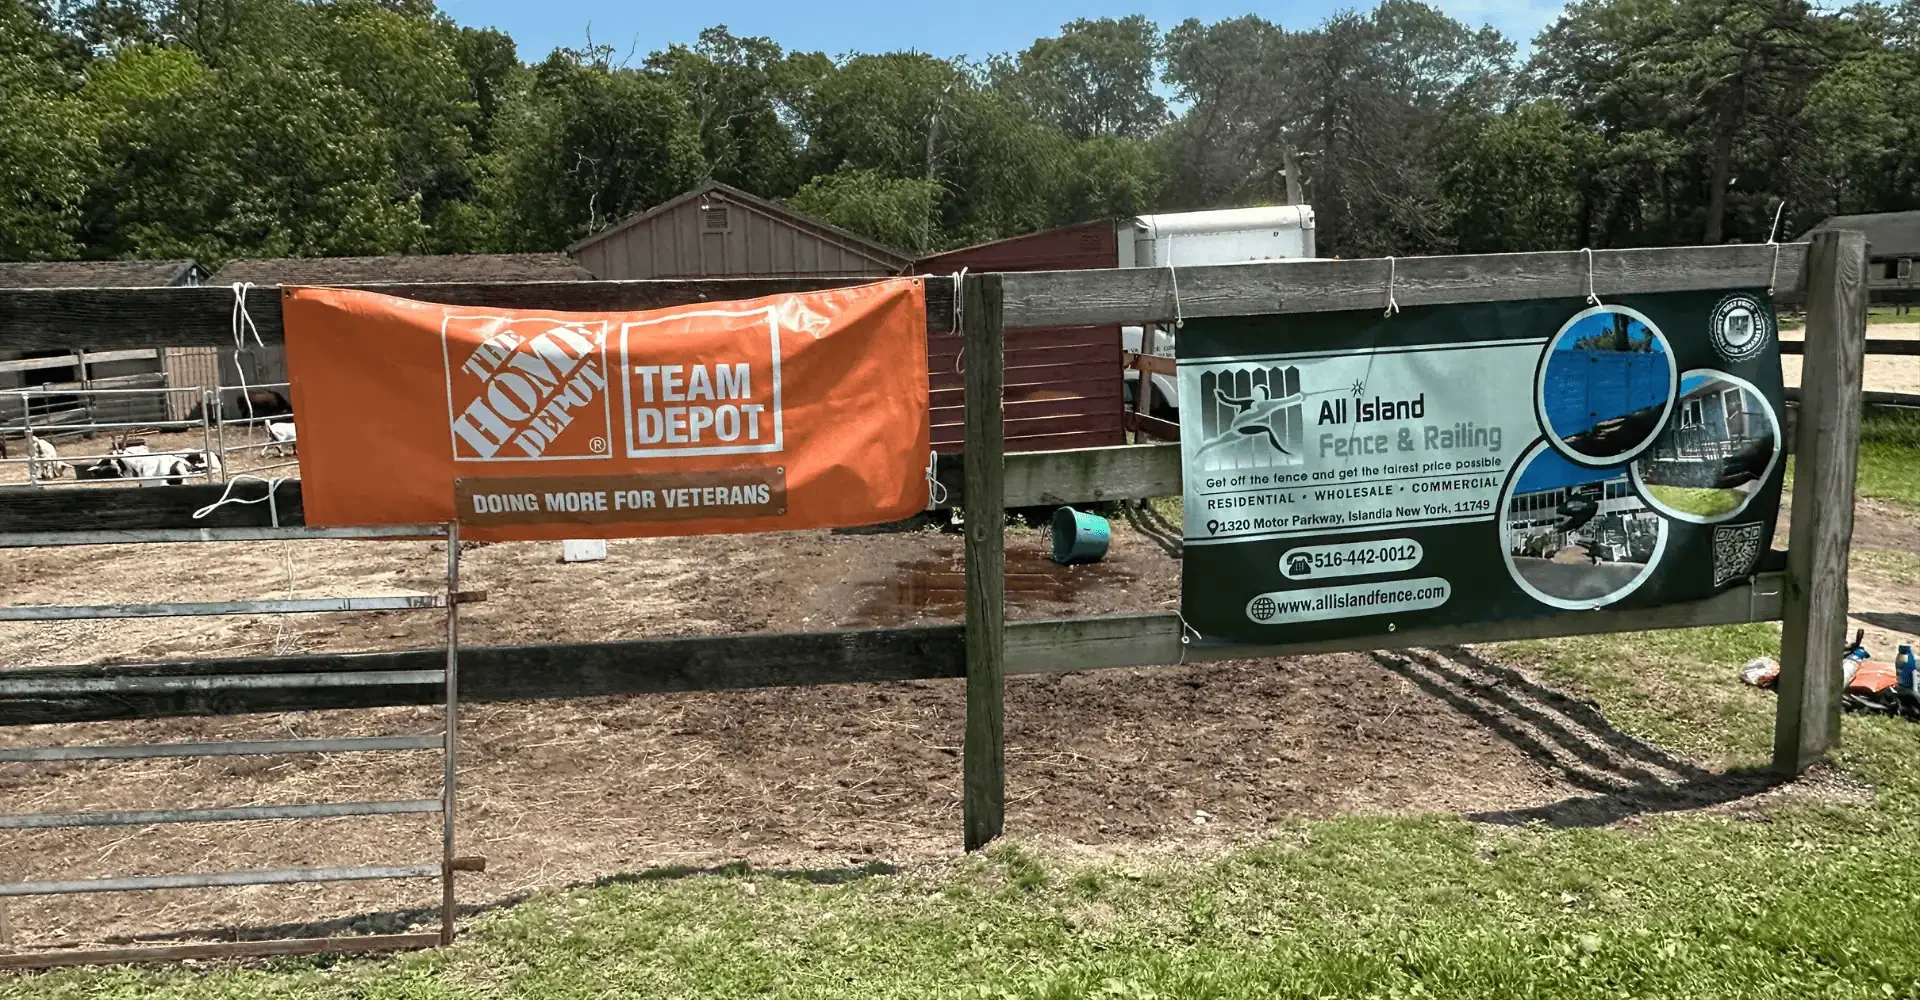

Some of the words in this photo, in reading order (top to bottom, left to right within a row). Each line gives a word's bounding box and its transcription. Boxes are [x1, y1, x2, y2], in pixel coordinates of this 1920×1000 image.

[461, 330, 526, 383] THE
[453, 323, 607, 458] HOME
[634, 363, 751, 402] TEAM
[513, 360, 606, 458] DEPOT
[637, 404, 765, 444] DEPOT
[1318, 398, 1347, 426] All
[1355, 392, 1425, 423] Island
[1319, 433, 1389, 459] Fence
[1397, 427, 1415, 452] &
[1423, 421, 1502, 452] Railing
[1206, 477, 1226, 489] Get
[1230, 475, 1246, 486] off
[1250, 474, 1269, 485] the
[1273, 472, 1308, 483] fence
[1312, 469, 1335, 480] and
[1338, 467, 1358, 480] get
[1362, 465, 1379, 477] the
[1383, 461, 1419, 474] fairest
[1422, 460, 1451, 474] price
[1455, 456, 1502, 471] possible
[472, 493, 540, 514] DOING
[544, 491, 608, 512] MORE
[614, 490, 657, 510] FOR
[661, 484, 770, 509] VETERANS
[1207, 493, 1296, 510] RESIDENTIAL
[1314, 485, 1393, 502] WHOLESALE
[1411, 477, 1500, 494] COMMERCIAL
[1219, 519, 1251, 532] 1320
[1253, 516, 1290, 530] Motor
[1292, 512, 1345, 528] Parkway,
[1348, 507, 1393, 522] Islandia
[1395, 505, 1421, 518] New
[1423, 503, 1452, 516] York,
[1454, 499, 1491, 513] 11749
[1314, 544, 1417, 569] 516-442-0012
[1277, 585, 1445, 614] www.allislandfence.com
